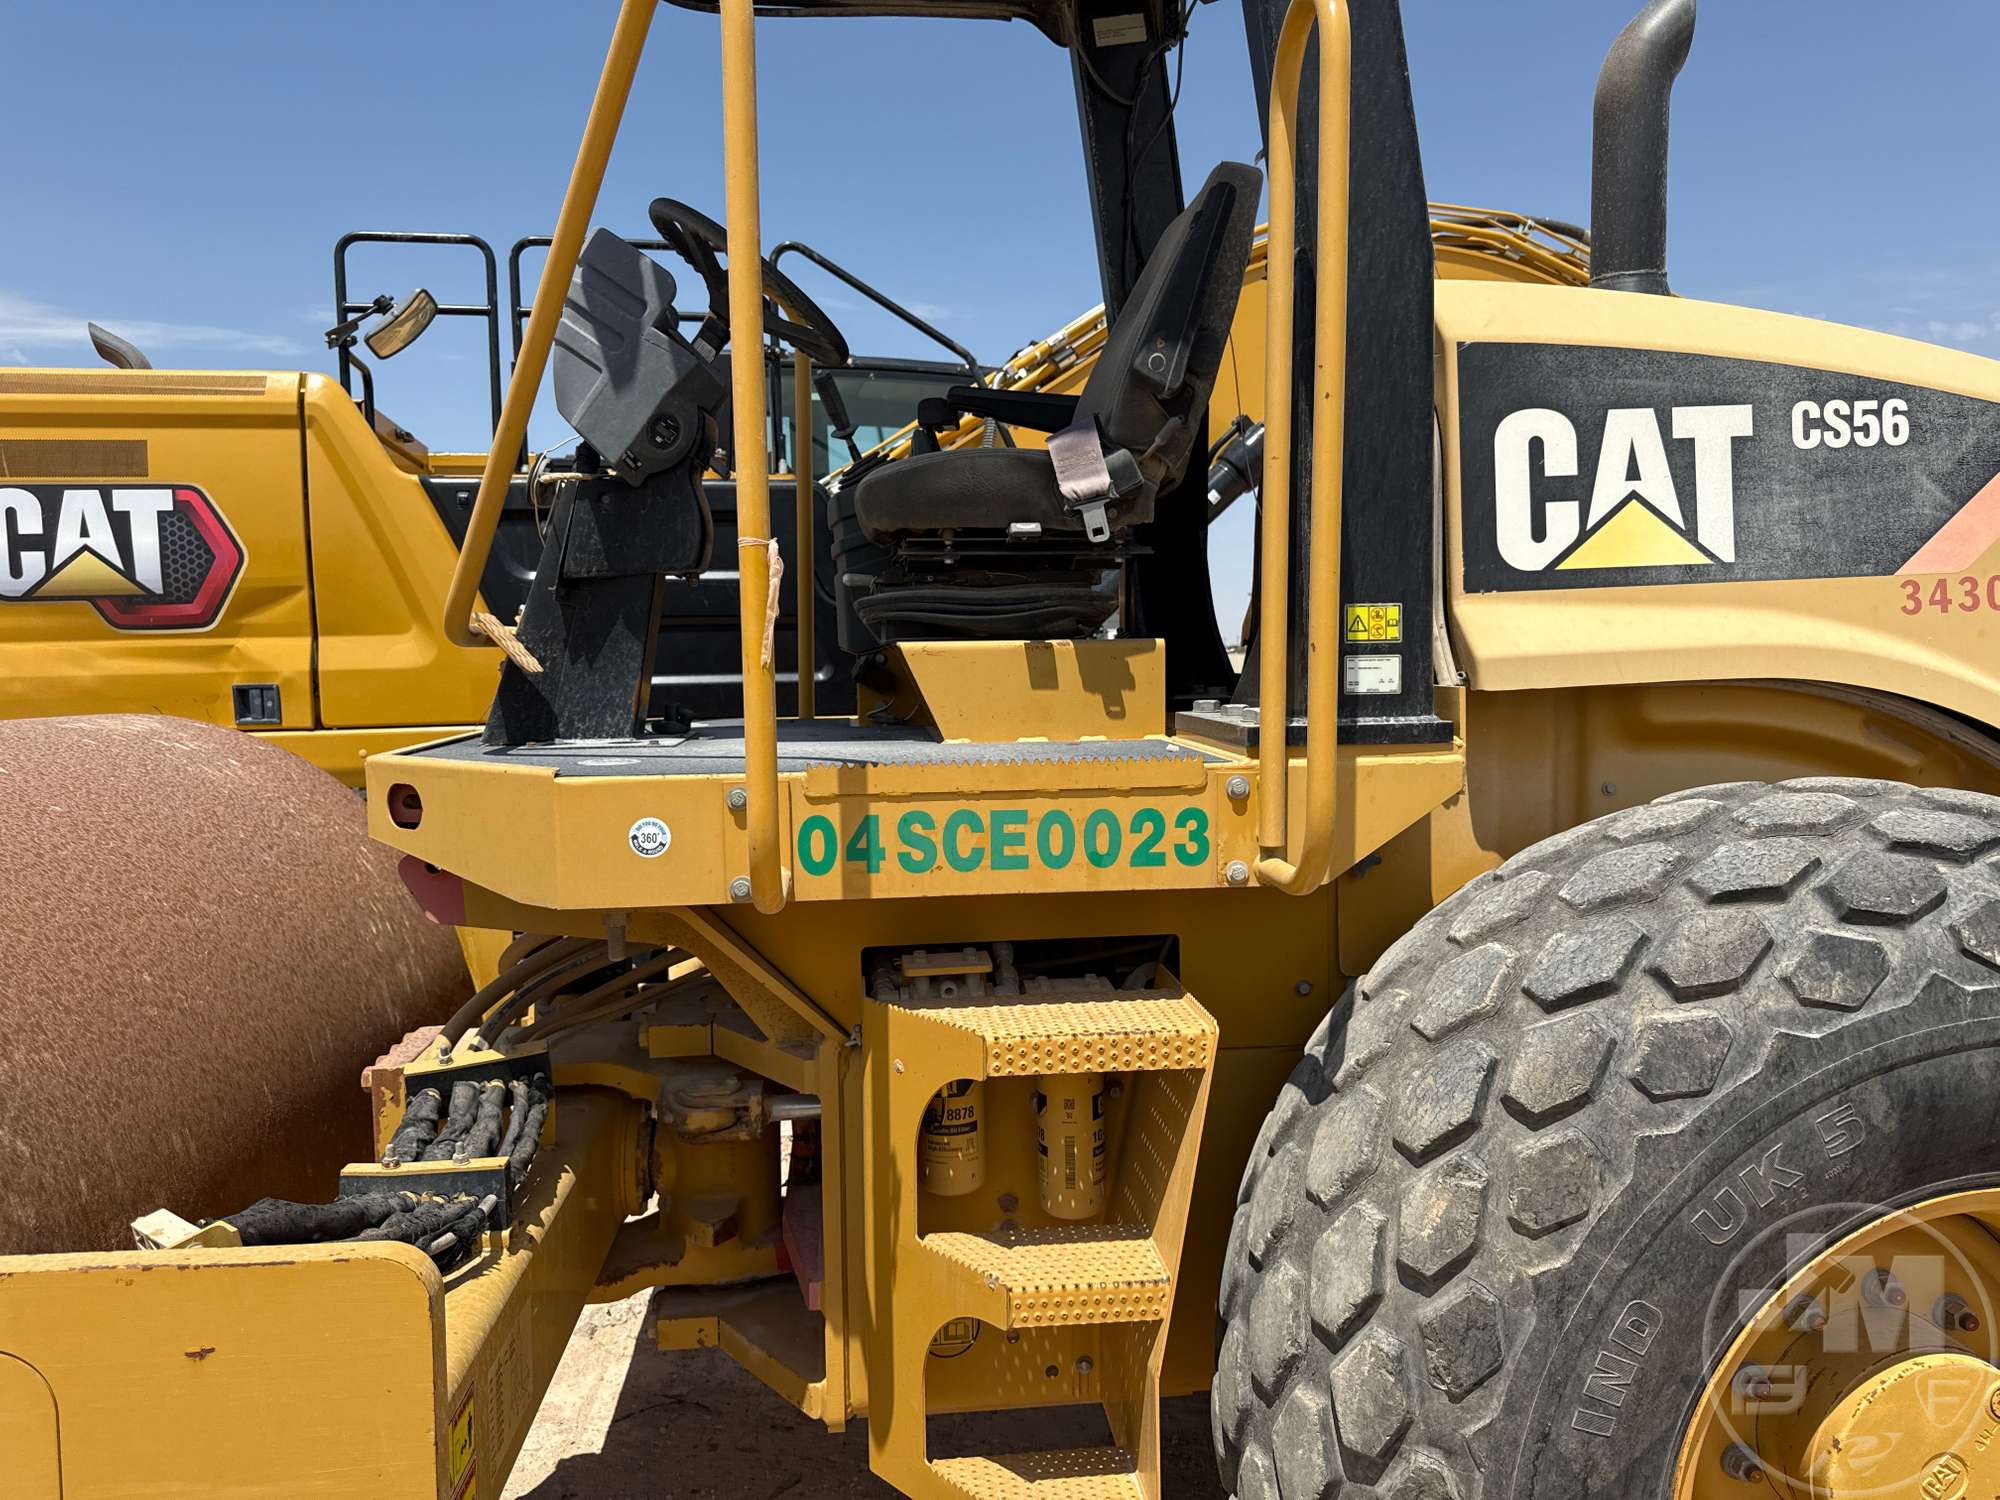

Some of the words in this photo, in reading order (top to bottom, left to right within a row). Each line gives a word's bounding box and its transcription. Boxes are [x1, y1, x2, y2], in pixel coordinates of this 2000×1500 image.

[1791, 398, 1910, 450] CS56
[1494, 404, 1753, 572] CAT
[0, 487, 174, 597] CAT
[797, 806, 1210, 876] 04SCE0023
